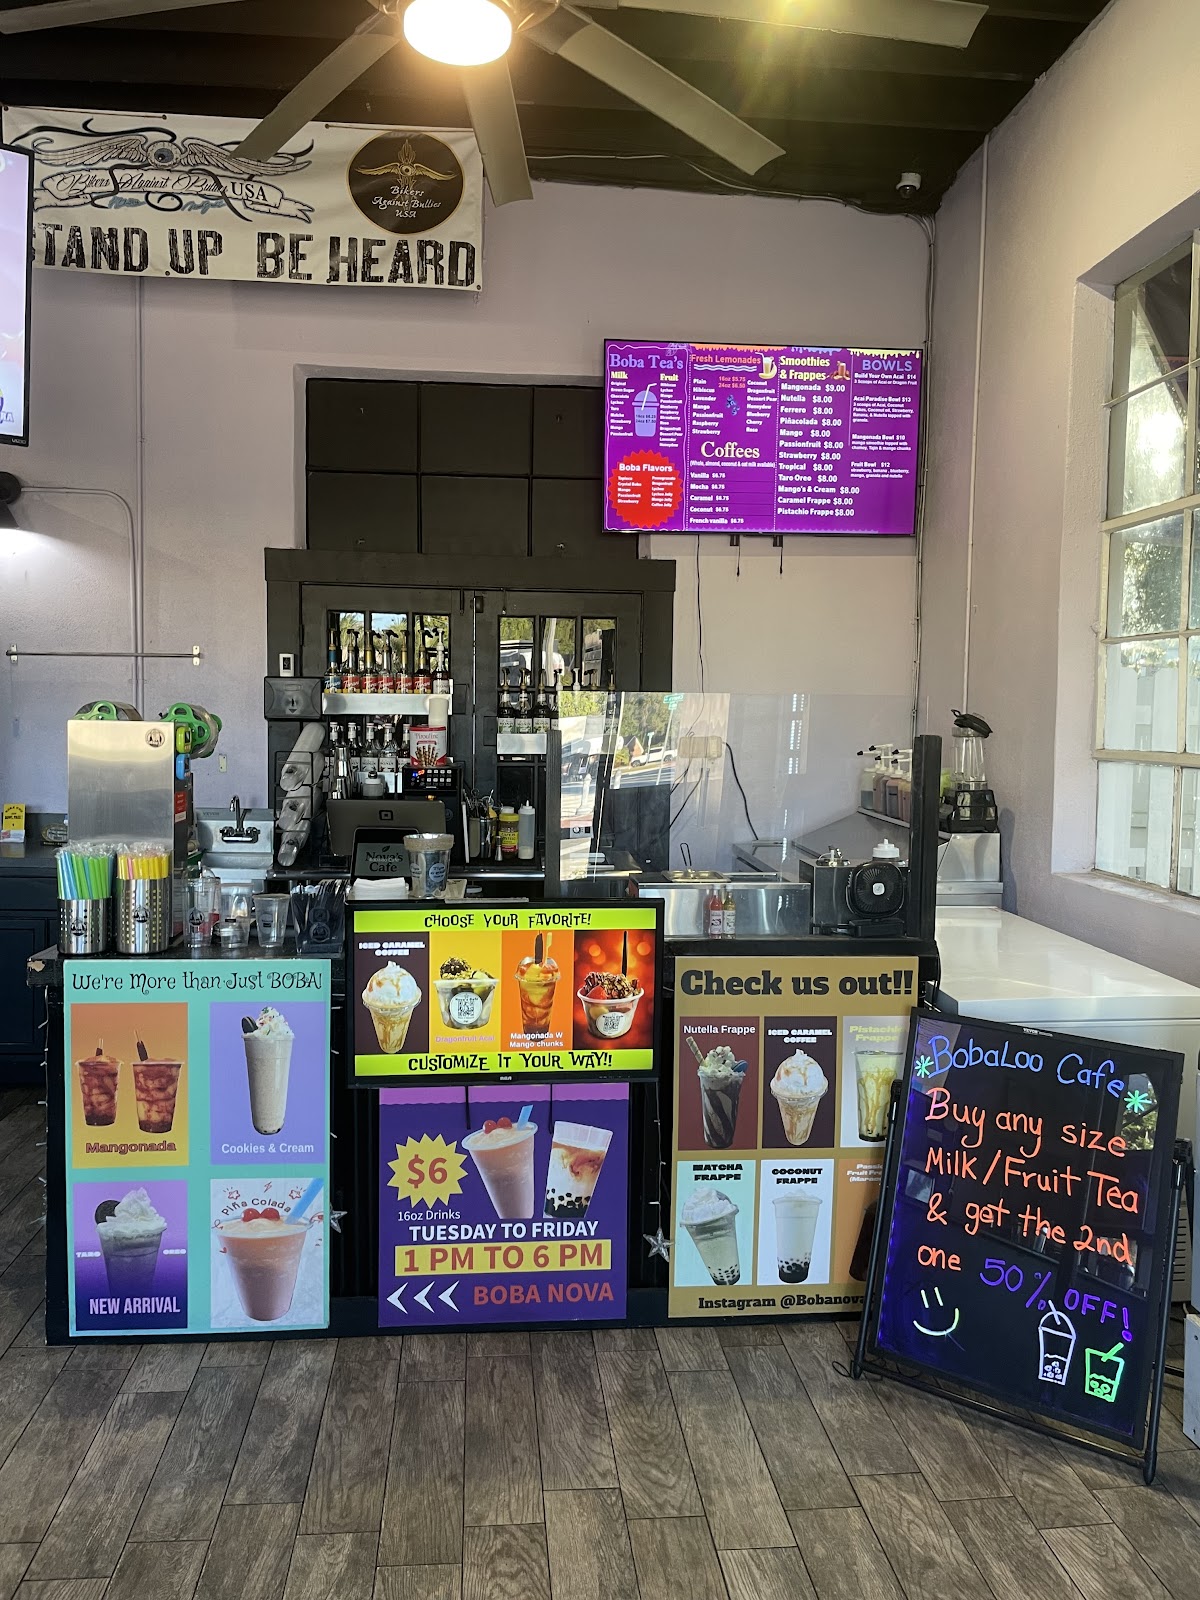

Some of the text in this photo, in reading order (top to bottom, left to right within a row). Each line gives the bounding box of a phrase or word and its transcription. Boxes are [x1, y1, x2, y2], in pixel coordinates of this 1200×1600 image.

[57, 173, 111, 194] Bikers
[118, 172, 169, 190] Against
[230, 181, 267, 202] USA
[390, 185, 424, 197] Bikers
[372, 195, 442, 209] Against Bullies
[395, 210, 417, 218] USA
[33, 222, 476, 288] TAND UP BE HEARD
[609, 354, 683, 370] Boba Tea's
[691, 354, 761, 364] Fresh Lemonades
[780, 356, 830, 367] Smoothies
[862, 359, 912, 372] BOWLS
[610, 371, 628, 379] Milk
[660, 373, 679, 382] Fruit
[780, 370, 827, 381] & Frappes
[781, 383, 846, 392] Mangonada $9.00
[812, 395, 833, 403] $8.00
[780, 406, 833, 415] Ferrero $8.00
[822, 418, 842, 426] $8.00
[780, 429, 831, 438] Mango $8.00
[701, 441, 760, 459] Coffees
[779, 440, 821, 448] Passionfruit
[824, 441, 844, 449] $8.00
[779, 452, 841, 461] Strawberry $8.00
[619, 464, 673, 473] Boba Flavors
[779, 463, 806, 471] Tropical
[813, 464, 833, 472] $8.00
[794, 474, 812, 482] Oreo
[817, 475, 838, 483] $8.00
[778, 486, 807, 494] Mango's
[840, 487, 860, 495] $8.00
[807, 497, 831, 505] Frappe
[833, 498, 853, 506] $8.00
[777, 508, 854, 517] Pistachio Frappe $8.00
[365, 852, 403, 862] Nova's
[369, 862, 397, 872] Cafe
[424, 912, 592, 928] CHOOSE YOUR FAVORITE!
[358, 941, 425, 950] ICED CARAMEL
[375, 948, 410, 956] COFFEE
[72, 971, 322, 995] We're More than Just BOBA!
[680, 970, 914, 996] Check us out!!
[683, 1025, 756, 1036] Nutella Frappe
[435, 1033, 476, 1044] Dragonfruit
[510, 1032, 554, 1042] Mangonada
[783, 1036, 817, 1044] COFFEE
[855, 1034, 898, 1043] Frappe
[509, 1039, 564, 1050] Mango chunks
[408, 1050, 613, 1071] CUSTOMIZE IT YOUR WAY!!
[928, 1035, 1125, 1099] BobaLoo Cafe
[925, 1087, 1127, 1158] Buy any size
[85, 1140, 177, 1155] Mangonada
[221, 1142, 314, 1154] Cookies & Cream
[407, 1154, 448, 1189] $6
[694, 1173, 741, 1181] FRAPPE
[1087, 1170, 1139, 1214] Tea
[221, 1197, 292, 1216] Piña Colada
[398, 1208, 461, 1222] 16oz Drinks
[409, 1221, 599, 1241] TUESDAY TO FRIDAY
[927, 1192, 1134, 1265] & get the 2nd
[404, 1243, 603, 1272] 1 PM TO 6 PM
[473, 1282, 615, 1305] BOBA NOVA
[917, 1245, 962, 1272] one
[1063, 1288, 1133, 1342] OFF!
[89, 1296, 181, 1315] NEW ARRIVAL
[698, 1296, 776, 1311] Instagram
